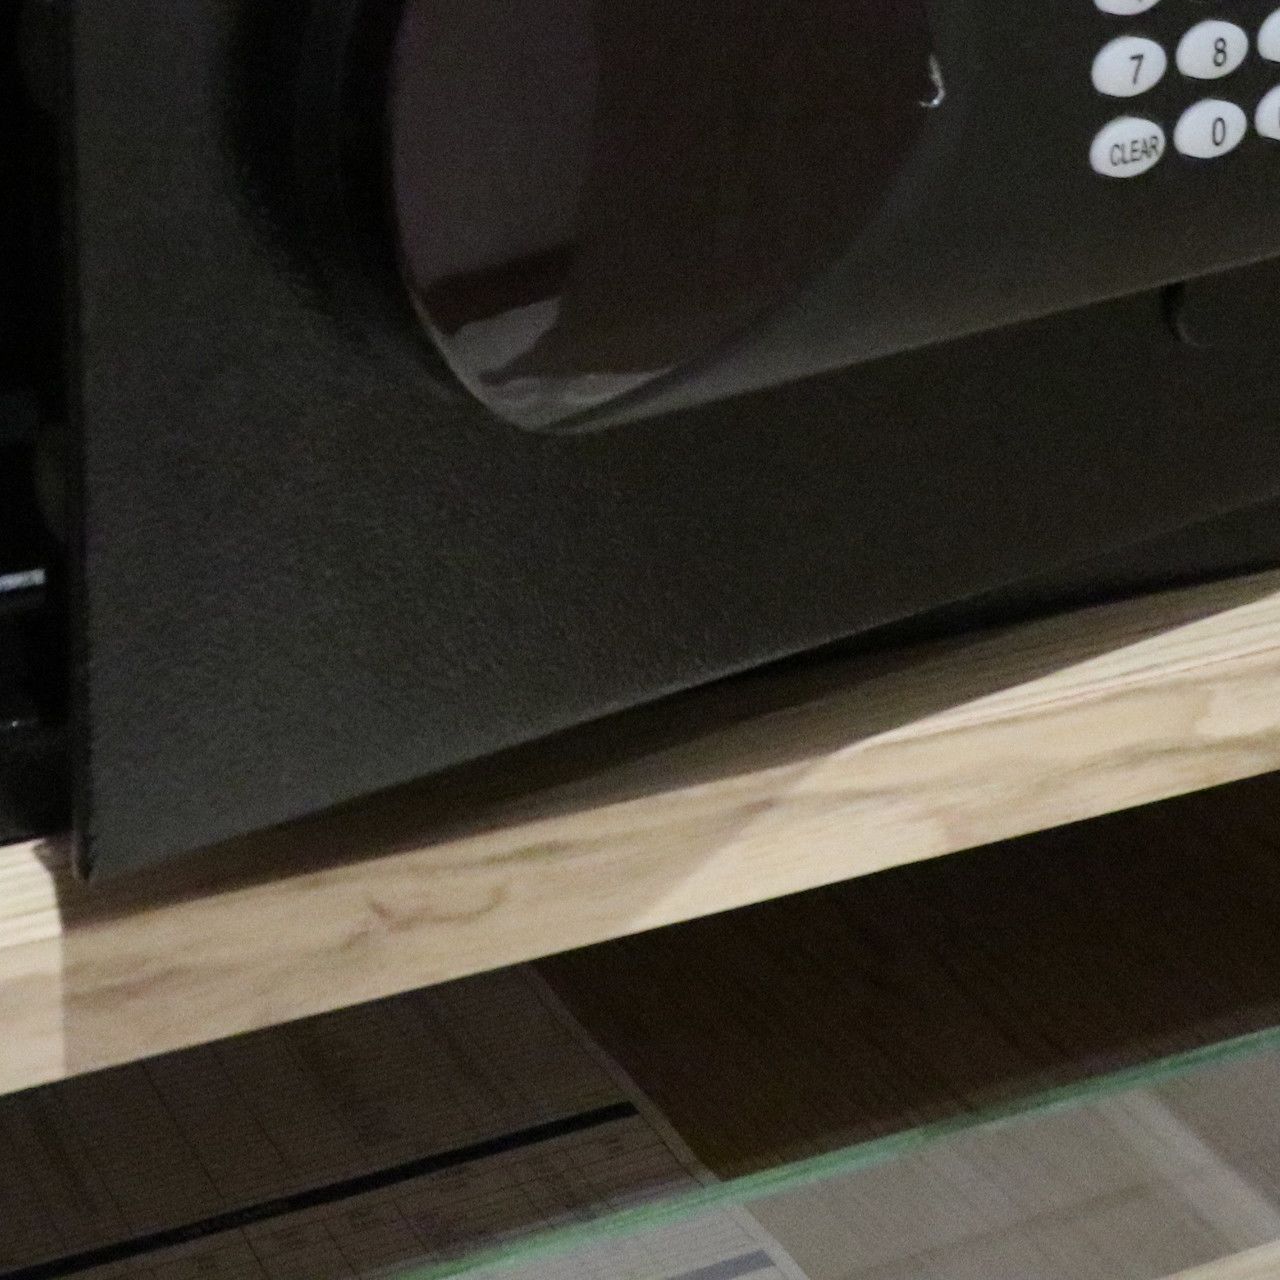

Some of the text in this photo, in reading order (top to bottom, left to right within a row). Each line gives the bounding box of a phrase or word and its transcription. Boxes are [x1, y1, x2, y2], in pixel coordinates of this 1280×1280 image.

[1129, 54, 1144, 85] 7
[1213, 37, 1227, 68] 8
[1109, 136, 1160, 167] CLEAR
[1212, 118, 1226, 147] 0
